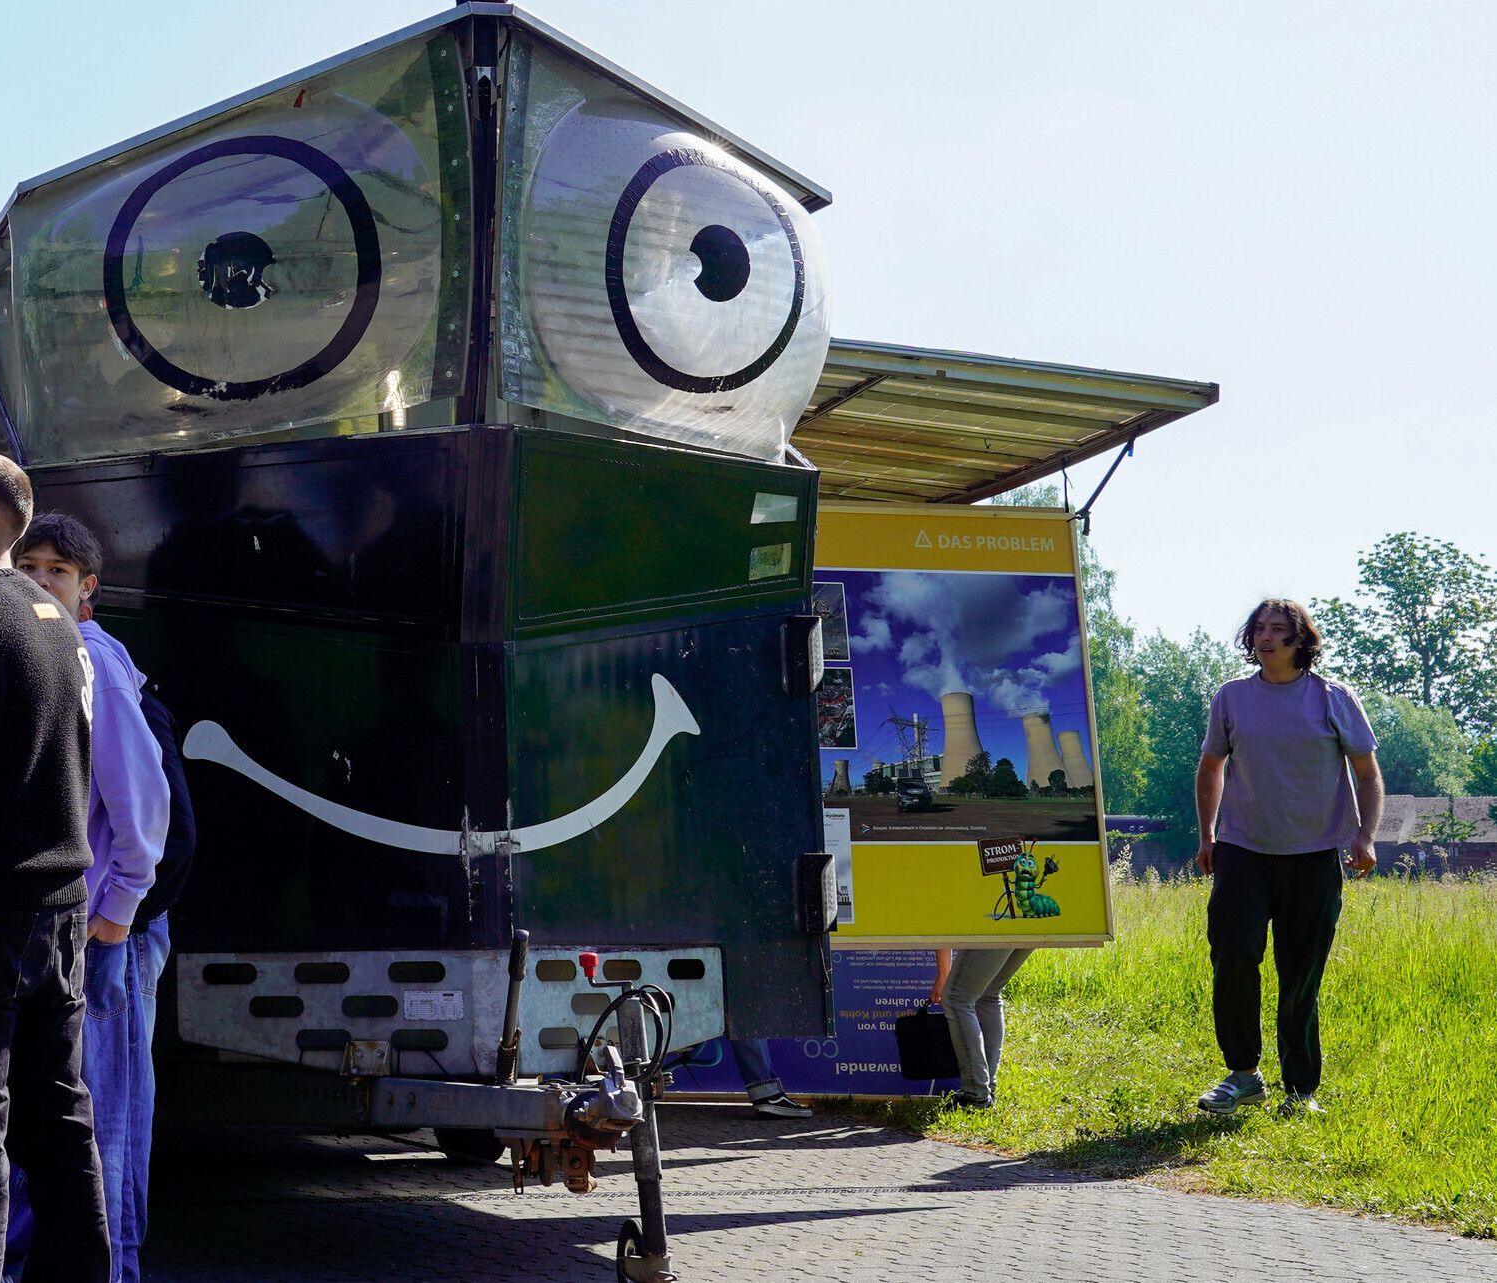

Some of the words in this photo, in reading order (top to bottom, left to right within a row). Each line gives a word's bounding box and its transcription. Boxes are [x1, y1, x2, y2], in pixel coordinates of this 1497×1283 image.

[937, 534, 972, 549] DAS
[975, 535, 1055, 551] PROBLEM
[984, 843, 1020, 857] STROM-
[875, 998, 911, 1007] Jahren
[839, 1011, 869, 1019] Kohle
[872, 1011, 891, 1019] und
